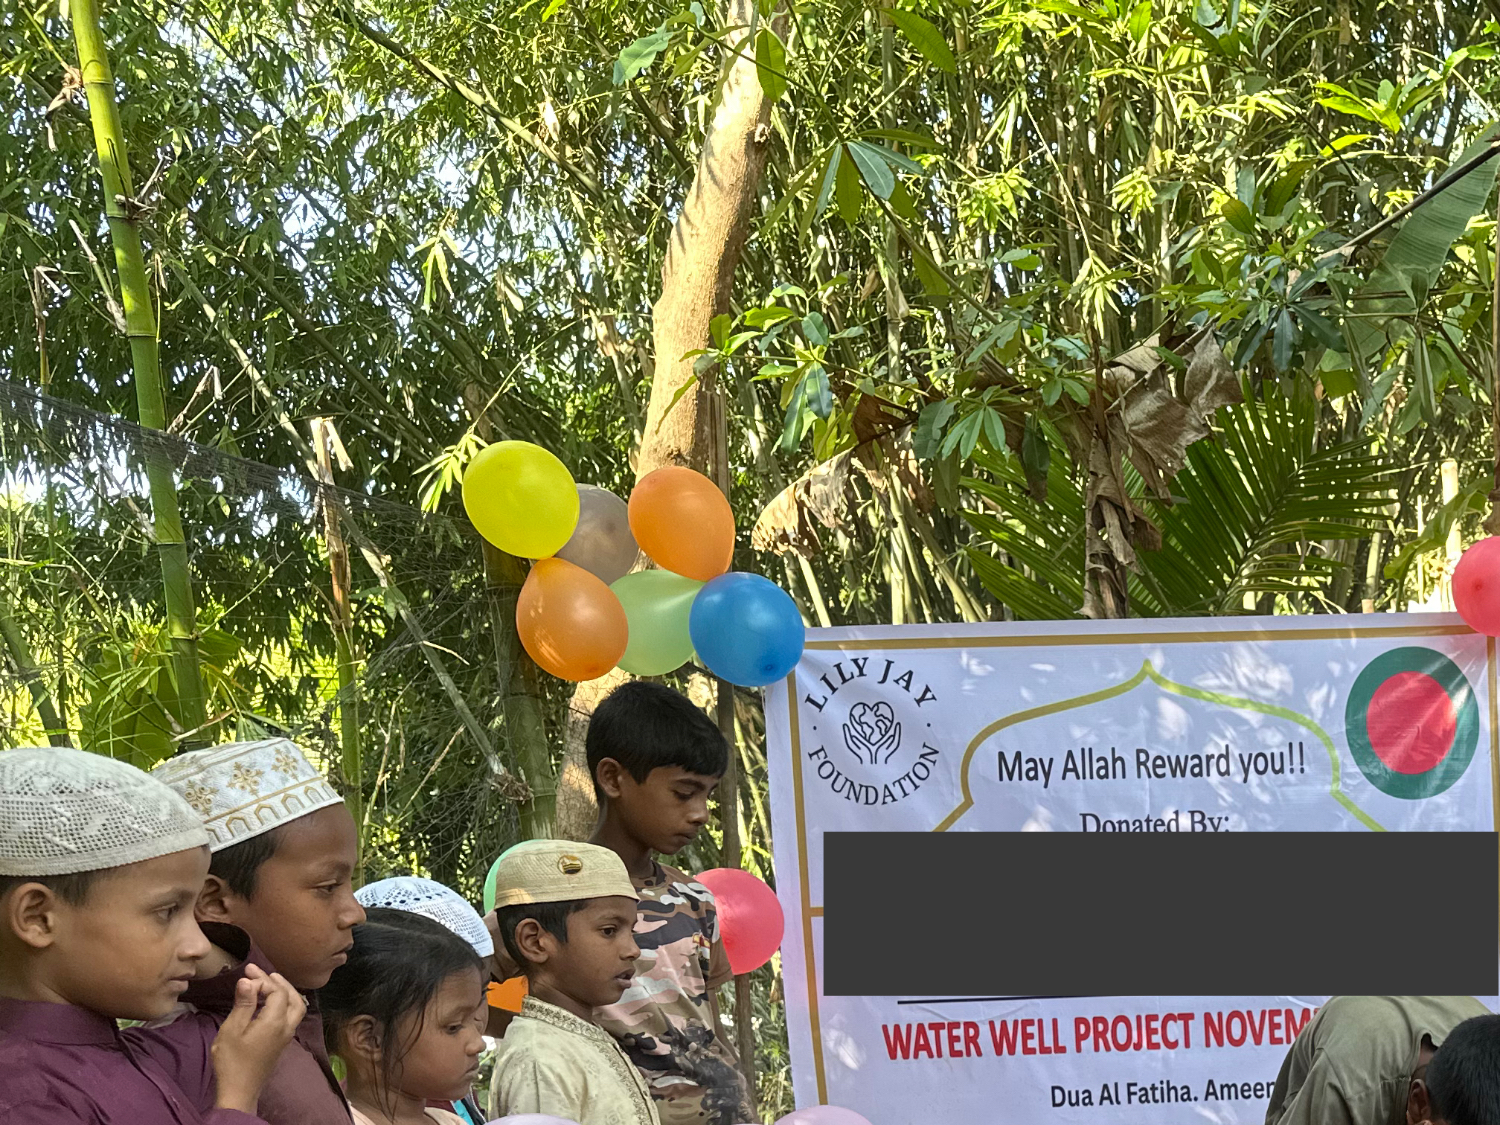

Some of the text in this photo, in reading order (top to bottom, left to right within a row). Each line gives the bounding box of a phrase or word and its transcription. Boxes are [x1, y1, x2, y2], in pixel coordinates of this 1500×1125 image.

[804, 657, 937, 713] LILY JAY
[808, 741, 940, 805] FOUNDATION
[998, 741, 1305, 789] May Allah Reward you!!
[1079, 810, 1181, 832] Donated
[881, 1007, 1319, 1061] WATER WELL PROJECT NOVEM
[1050, 1085, 1094, 1108] Dua
[1099, 1082, 1121, 1106] Al
[1126, 1079, 1199, 1105] Fatiha.
